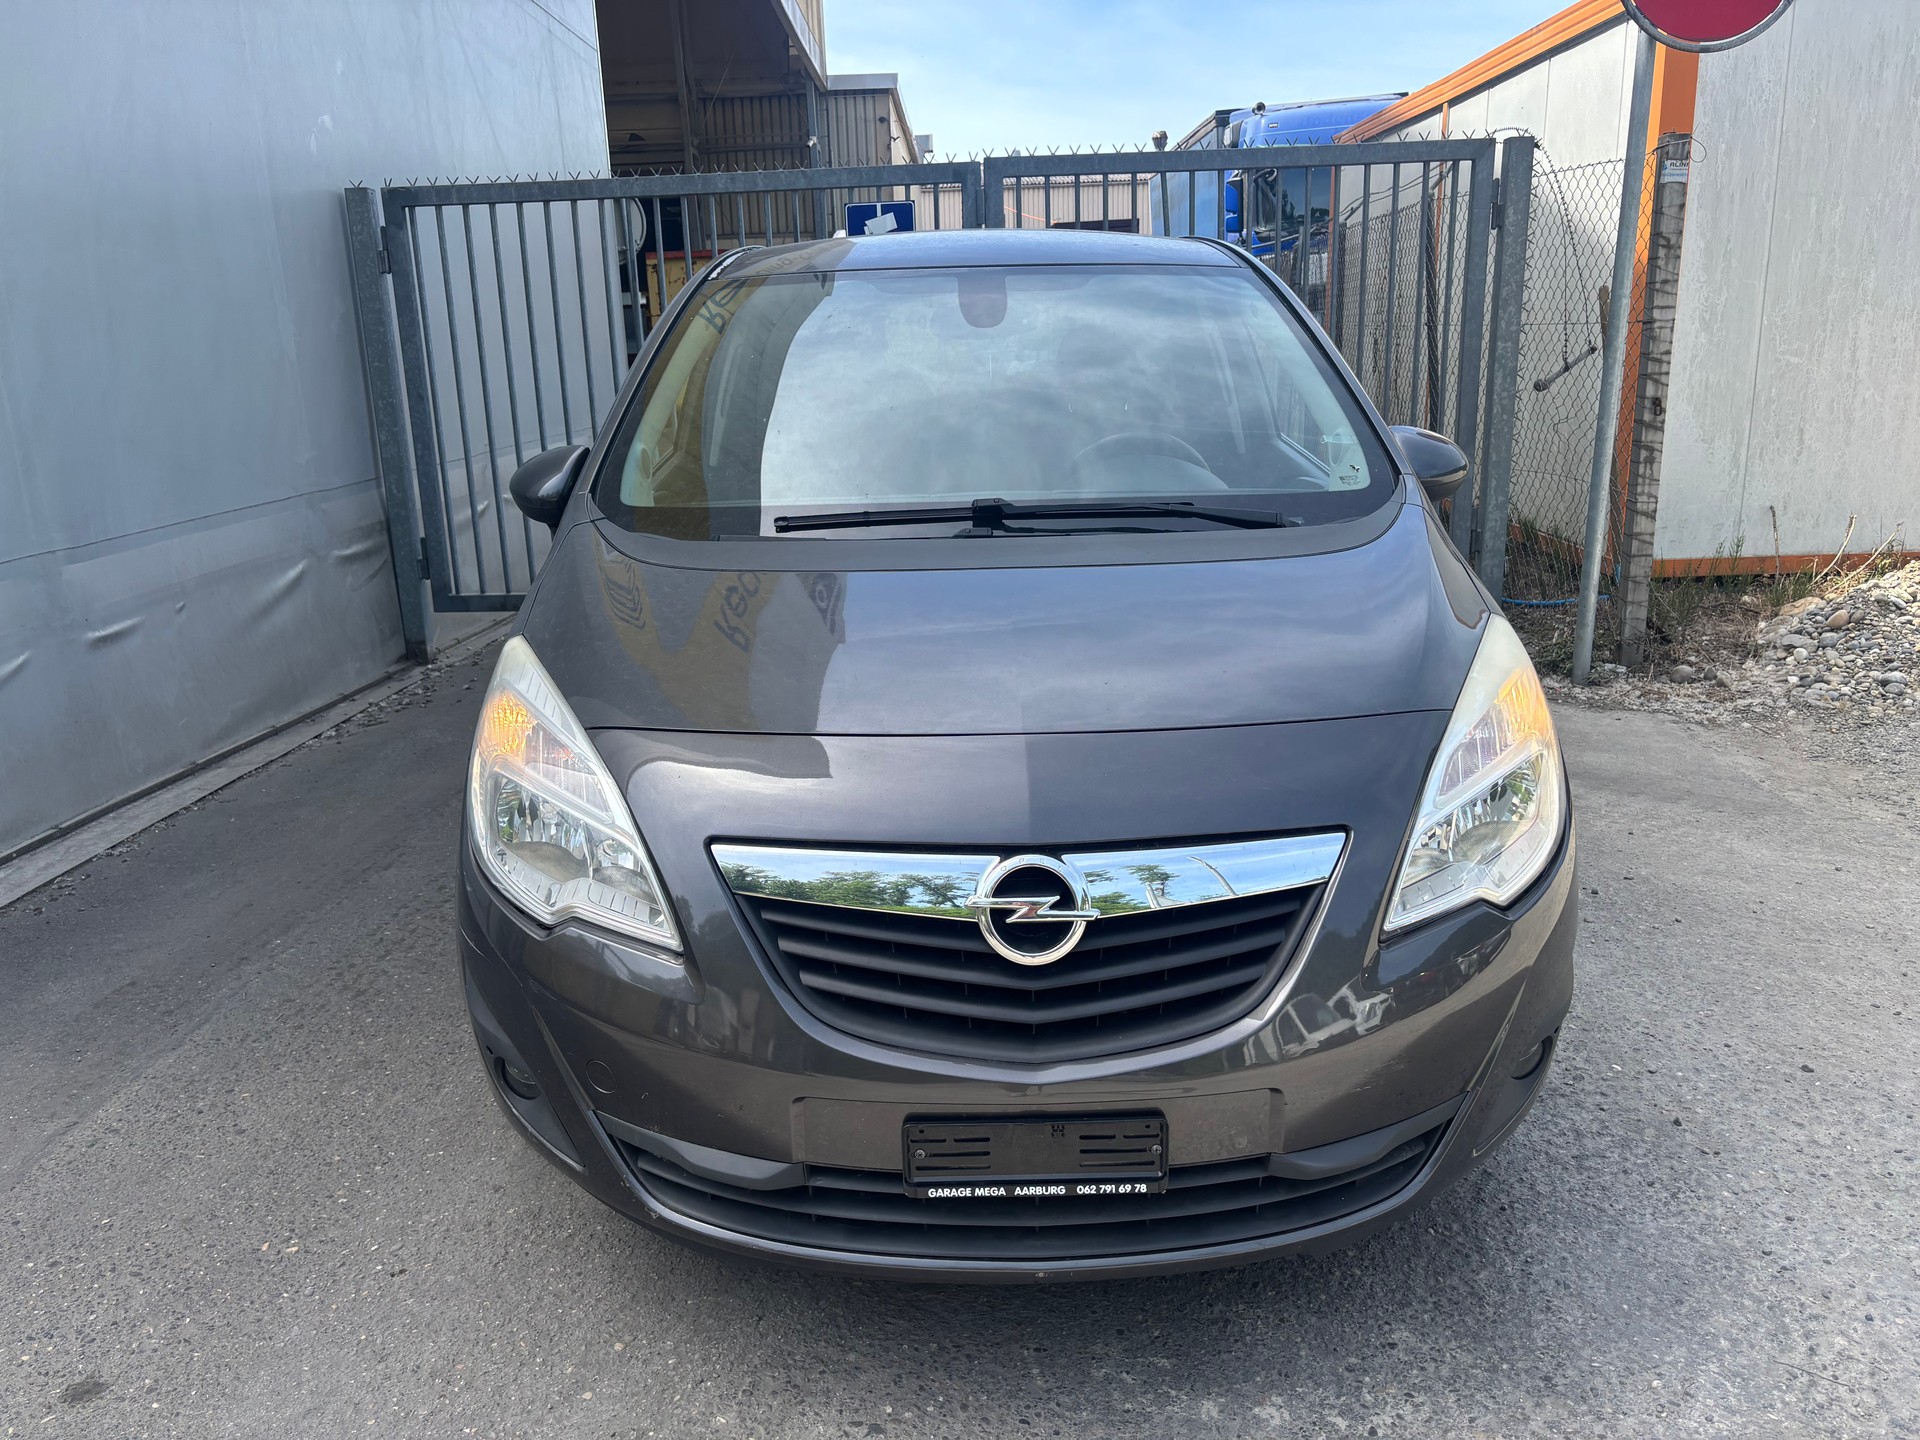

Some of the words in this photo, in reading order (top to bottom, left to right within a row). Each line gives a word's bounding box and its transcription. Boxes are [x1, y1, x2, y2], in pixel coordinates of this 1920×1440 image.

[927, 1187, 972, 1198] GARAGE
[974, 1186, 1007, 1197] MEGA
[1014, 1185, 1067, 1196] AARBURG
[1076, 1185, 1097, 1195] 062
[1099, 1184, 1116, 1195] 791
[1118, 1184, 1132, 1194] 69
[1133, 1183, 1148, 1194] 78
